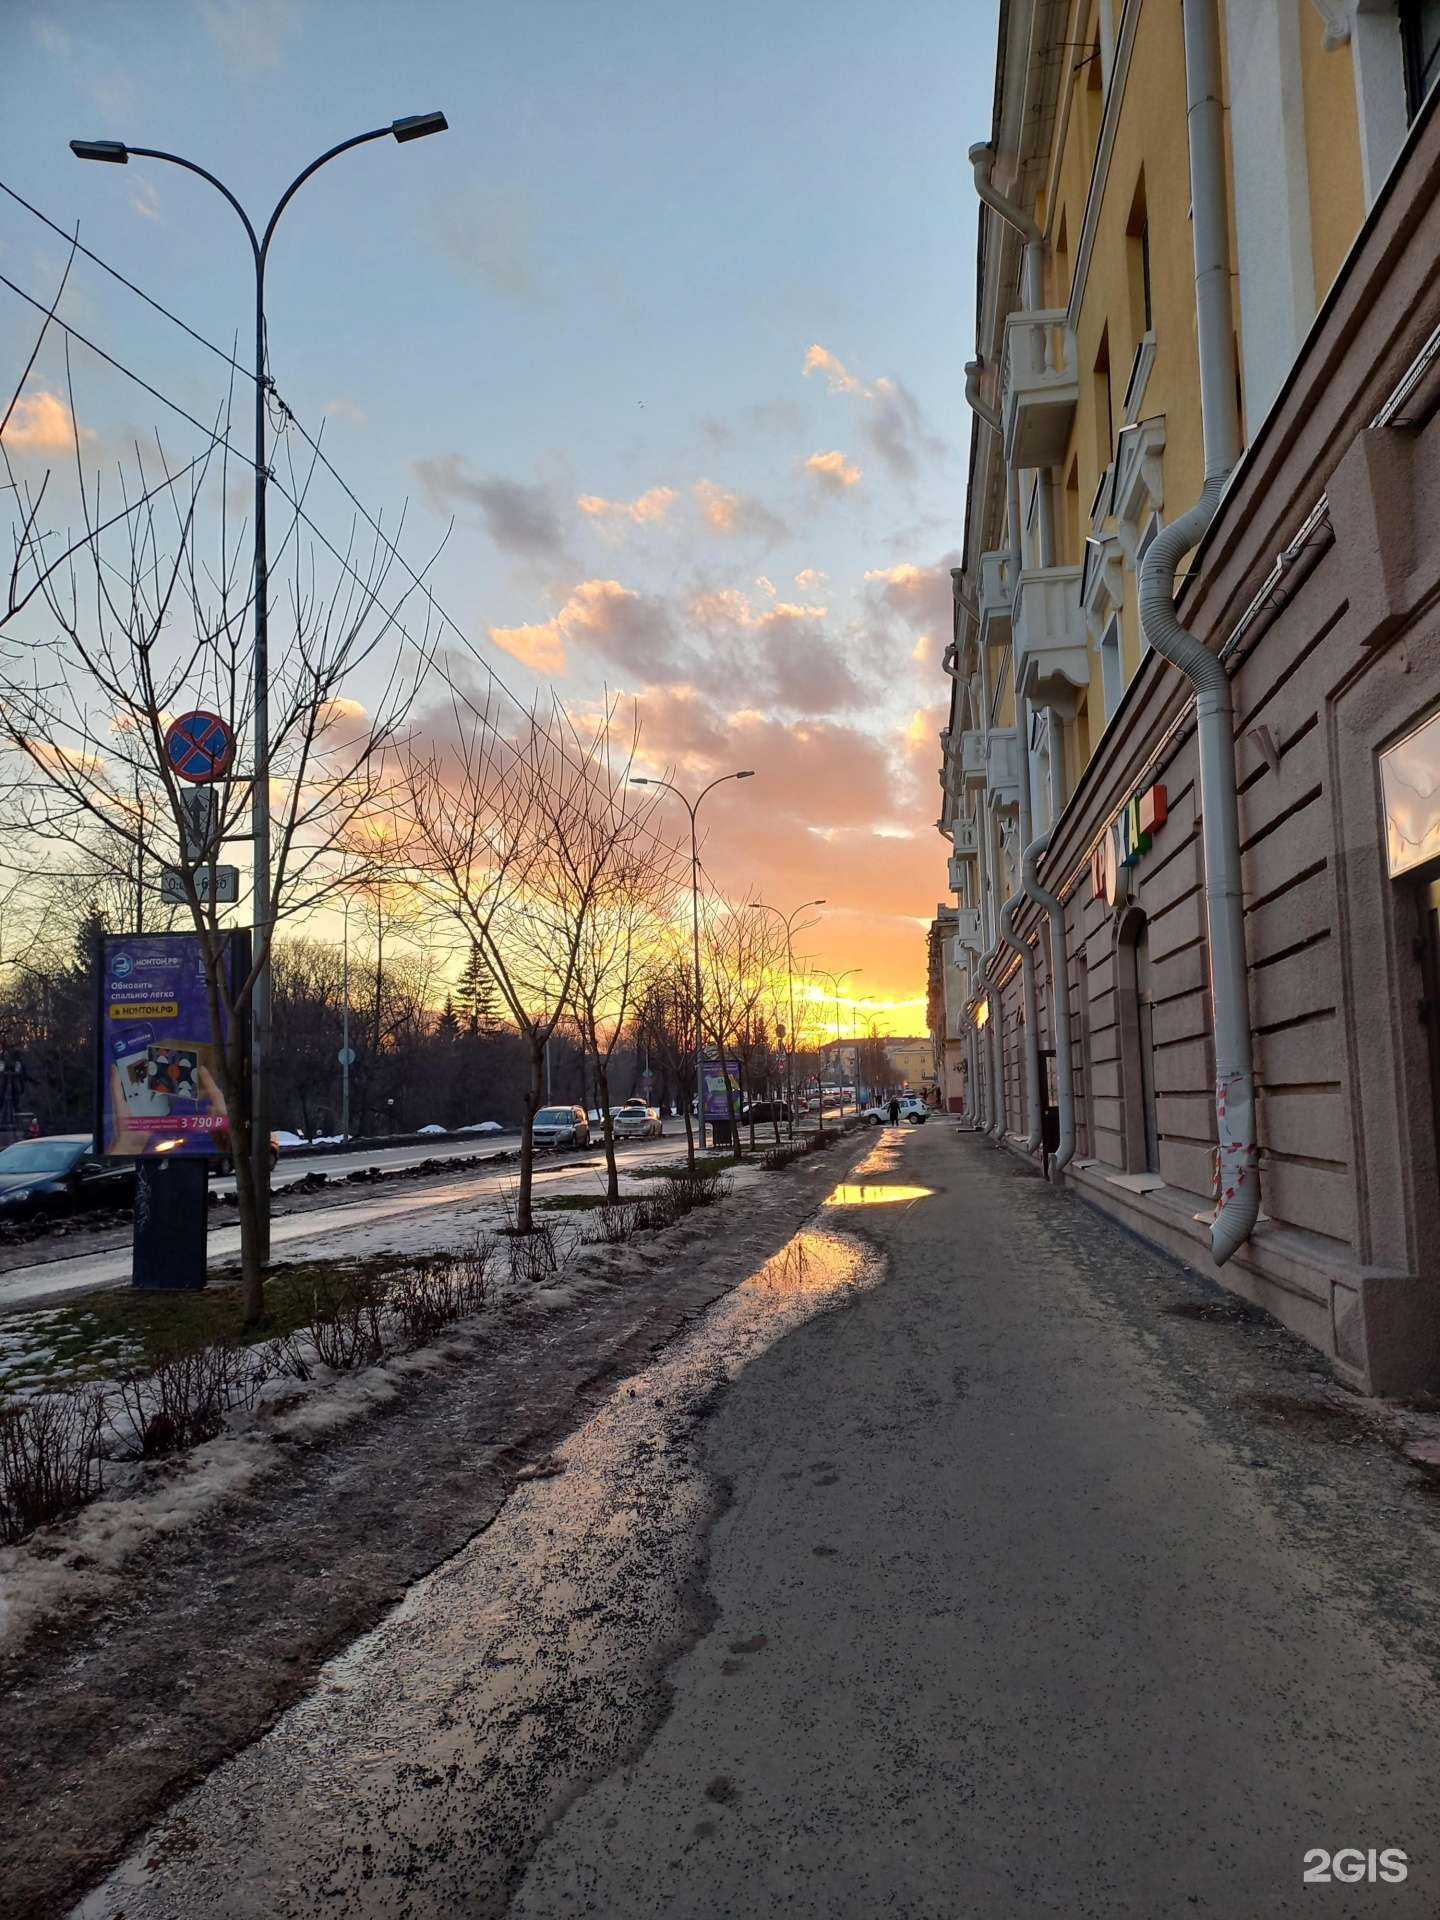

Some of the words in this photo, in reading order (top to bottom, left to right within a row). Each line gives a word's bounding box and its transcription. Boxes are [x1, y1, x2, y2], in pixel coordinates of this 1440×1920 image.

[111, 982, 152, 990] Обновить
[150, 991, 175, 999] легко
[180, 1118, 188, 1128] 3
[192, 1117, 212, 1128] 790
